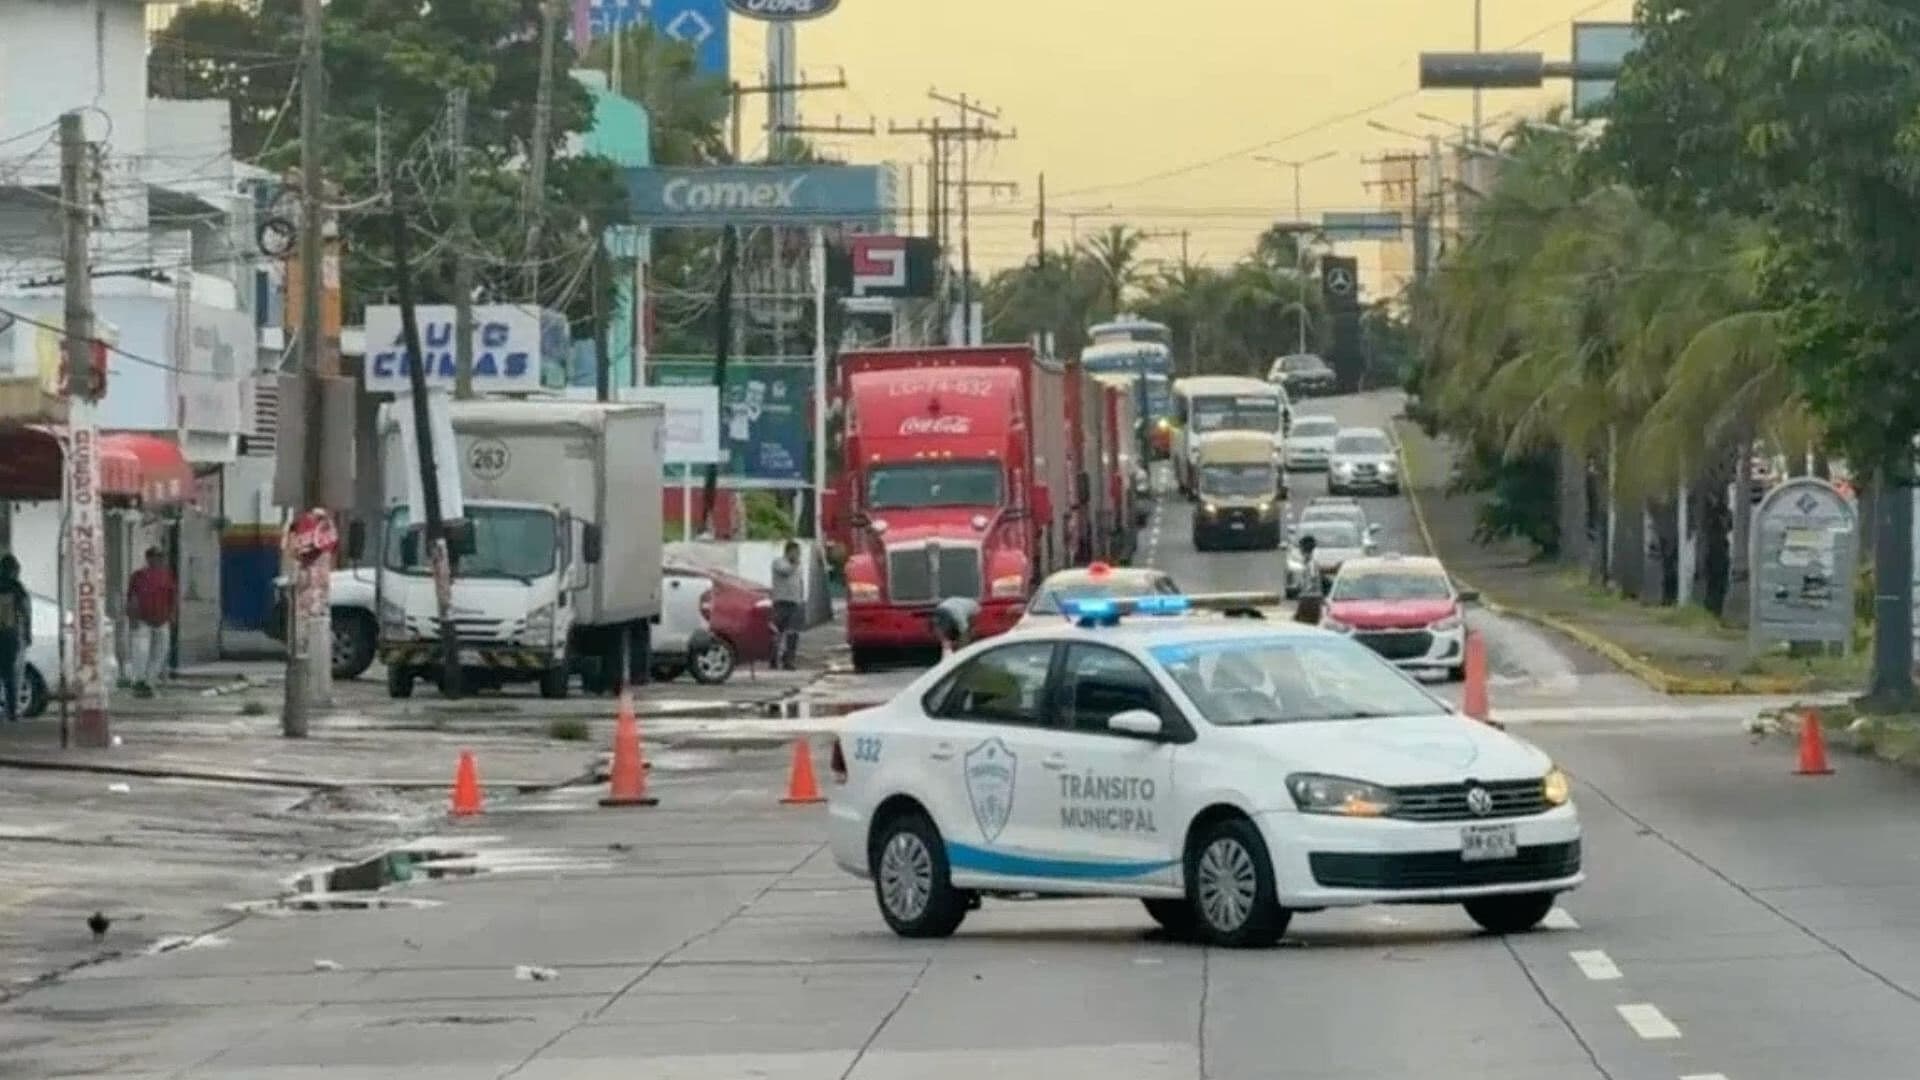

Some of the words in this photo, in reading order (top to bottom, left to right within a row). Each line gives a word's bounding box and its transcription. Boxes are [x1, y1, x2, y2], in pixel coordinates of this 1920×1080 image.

[662, 174, 808, 212] Comex
[394, 322, 510, 347] UO
[899, 415, 973, 436] Coca-Cola
[472, 448, 506, 470] 263
[854, 737, 883, 763] 332
[1058, 767, 1156, 801] TRÁNSITO
[1060, 806, 1160, 833] MUNICIPAL
